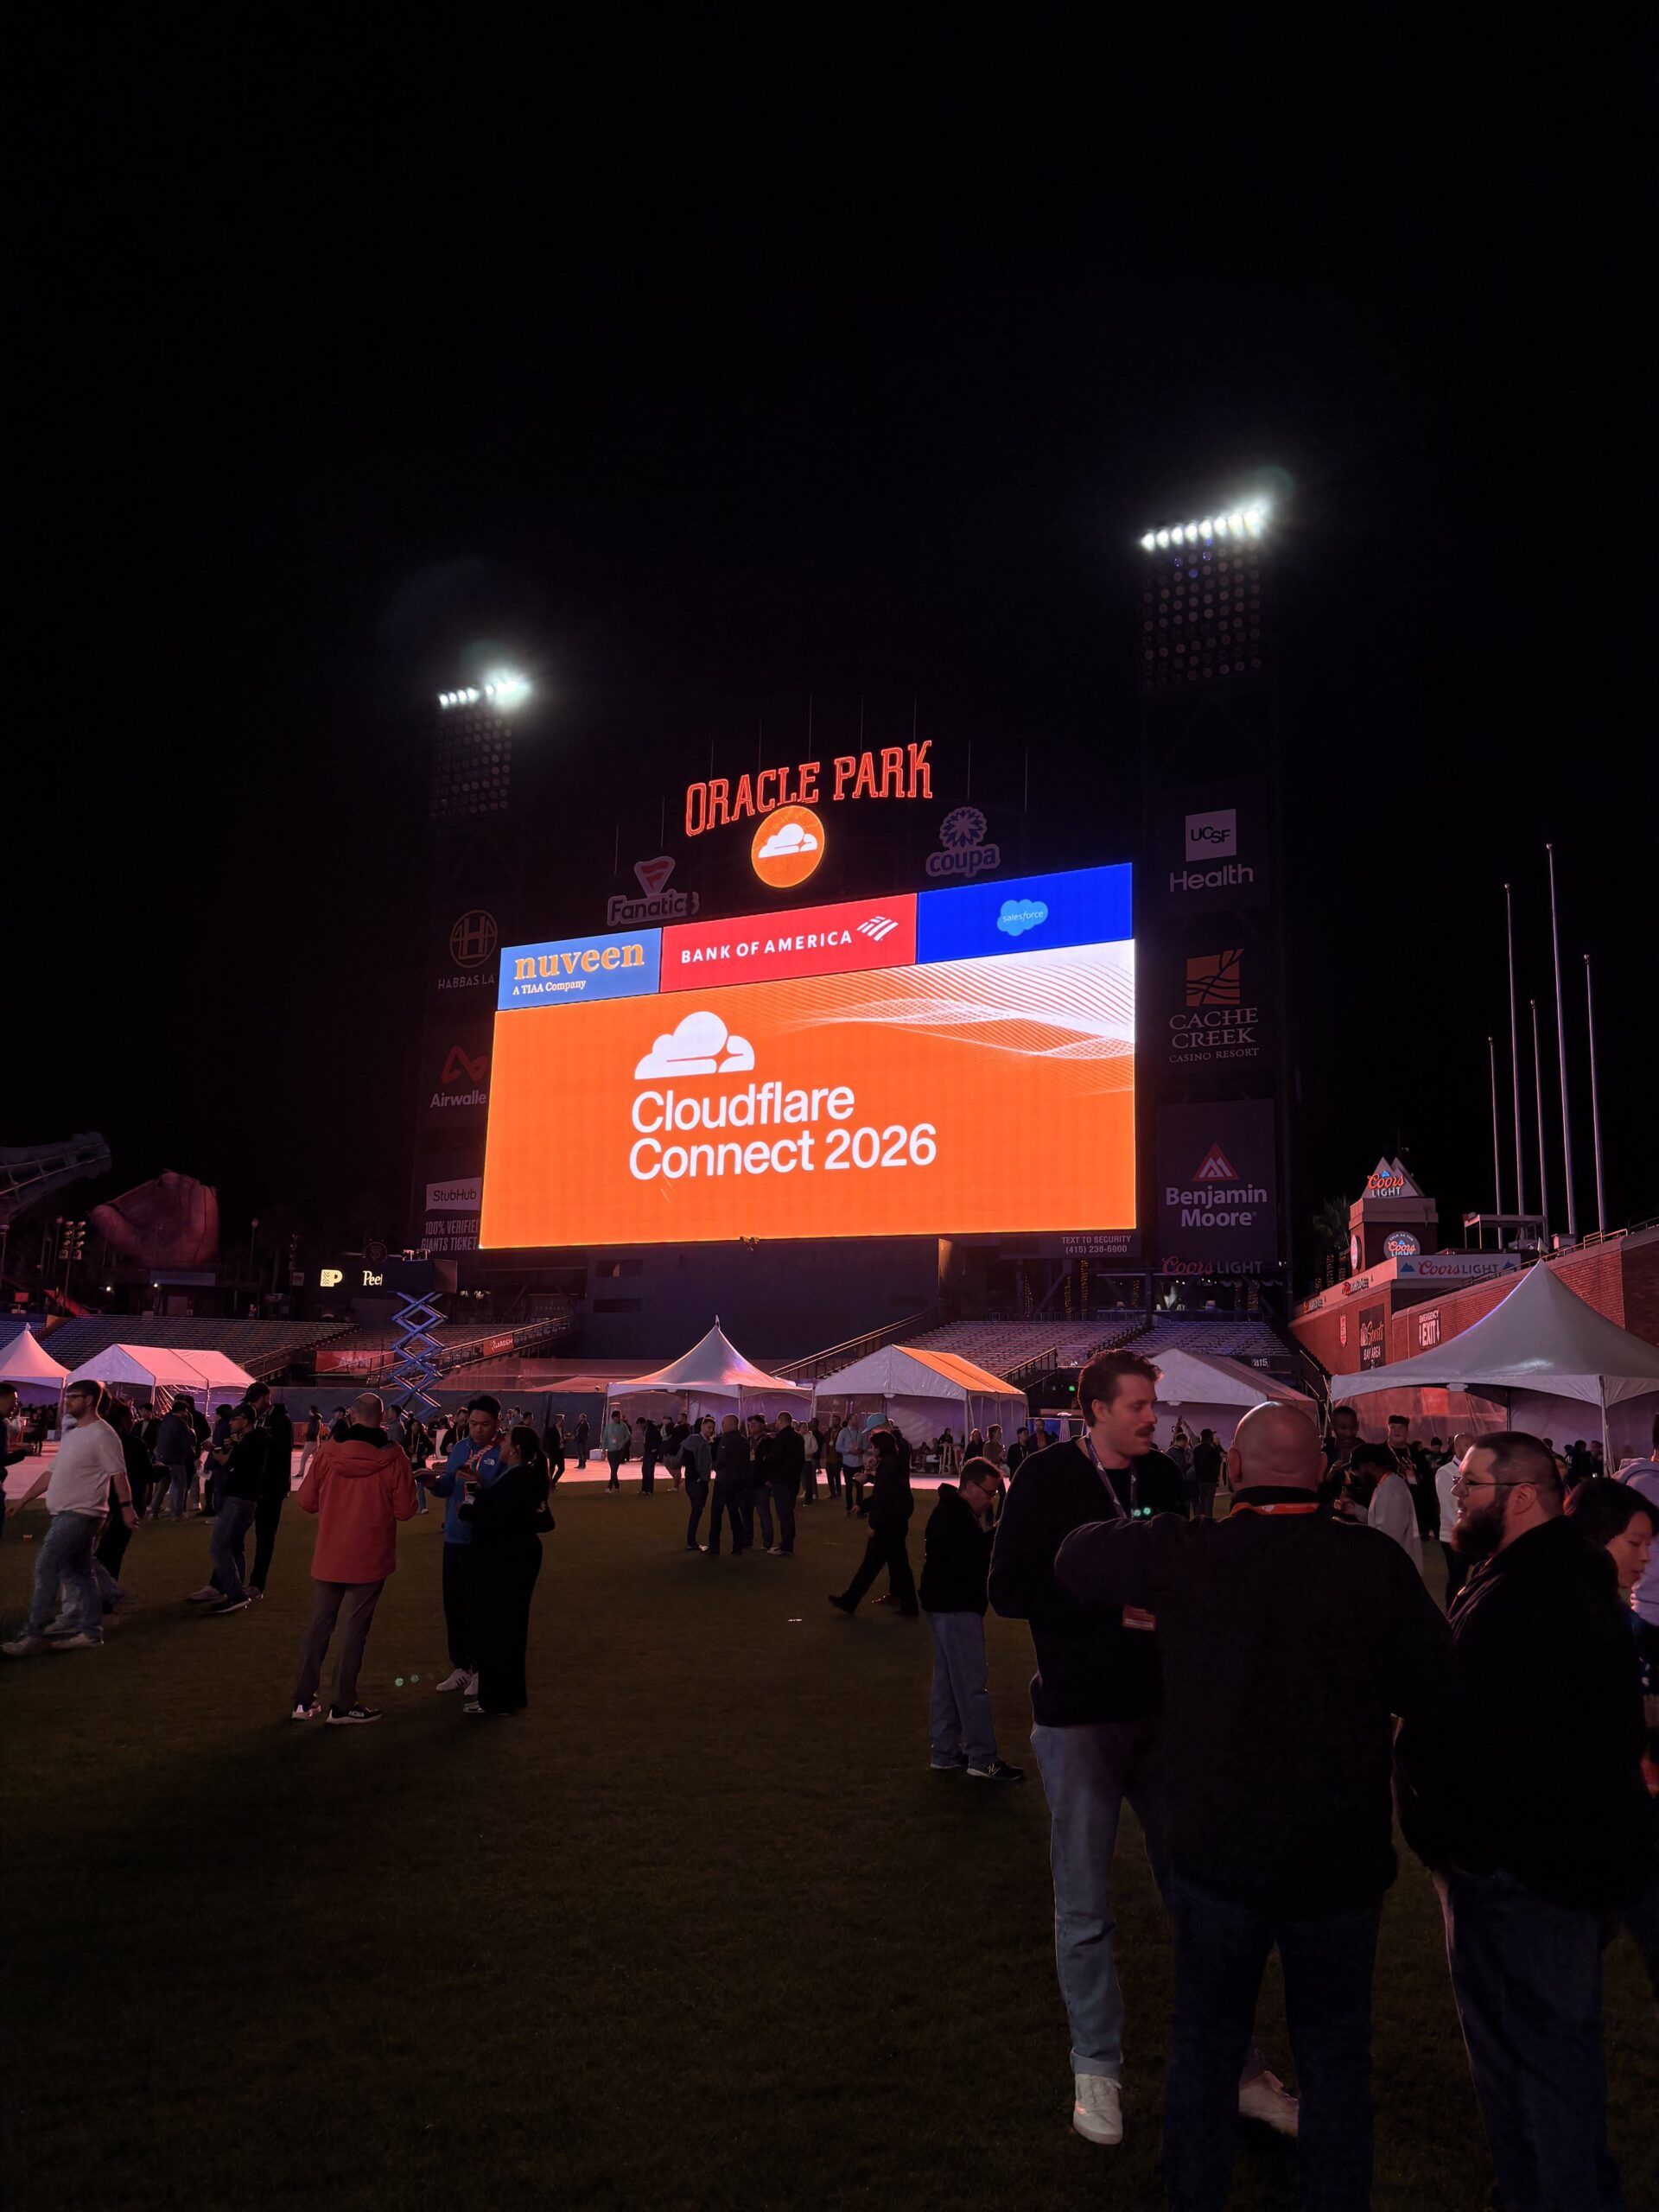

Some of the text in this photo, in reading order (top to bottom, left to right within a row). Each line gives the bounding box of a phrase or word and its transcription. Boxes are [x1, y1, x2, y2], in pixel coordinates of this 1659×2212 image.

[686, 741, 932, 837] ORACLE PARK
[1191, 826, 1230, 843] UCSF
[930, 848, 996, 873] coupa
[1169, 863, 1254, 893] Health
[1003, 911, 1044, 923] salesforce
[681, 930, 852, 963] BANK OF AMERICA
[514, 944, 645, 980] nuveen
[438, 973, 495, 989] HABBAS LA
[512, 980, 587, 995] A TIAA Company
[1169, 1007, 1259, 1030] CACHE
[1172, 1027, 1256, 1049] CREEK
[1169, 1047, 1261, 1063] CASINO RESORT
[429, 1090, 486, 1108] Airwalle
[632, 1082, 855, 1133] Cloudflare
[629, 1123, 937, 1180] Connect 2026
[1367, 1173, 1404, 1190] Coors
[433, 1188, 477, 1202] StubHub
[1166, 1183, 1268, 1209] Benjamin
[1371, 1187, 1401, 1198] LIGHT
[1181, 1209, 1252, 1227] Moore
[425, 1220, 445, 1236] 100%
[421, 1236, 478, 1252] GIANTS TICKET
[1094, 1235, 1131, 1243] SECURITY
[1388, 1241, 1416, 1252] Coors
[1161, 1255, 1262, 1275] Coors LIGHT
[1418, 1261, 1498, 1275] Coors LIGHT
[1422, 1319, 1436, 1346] EXIT
[493, 1339, 513, 1349] GARDEN
